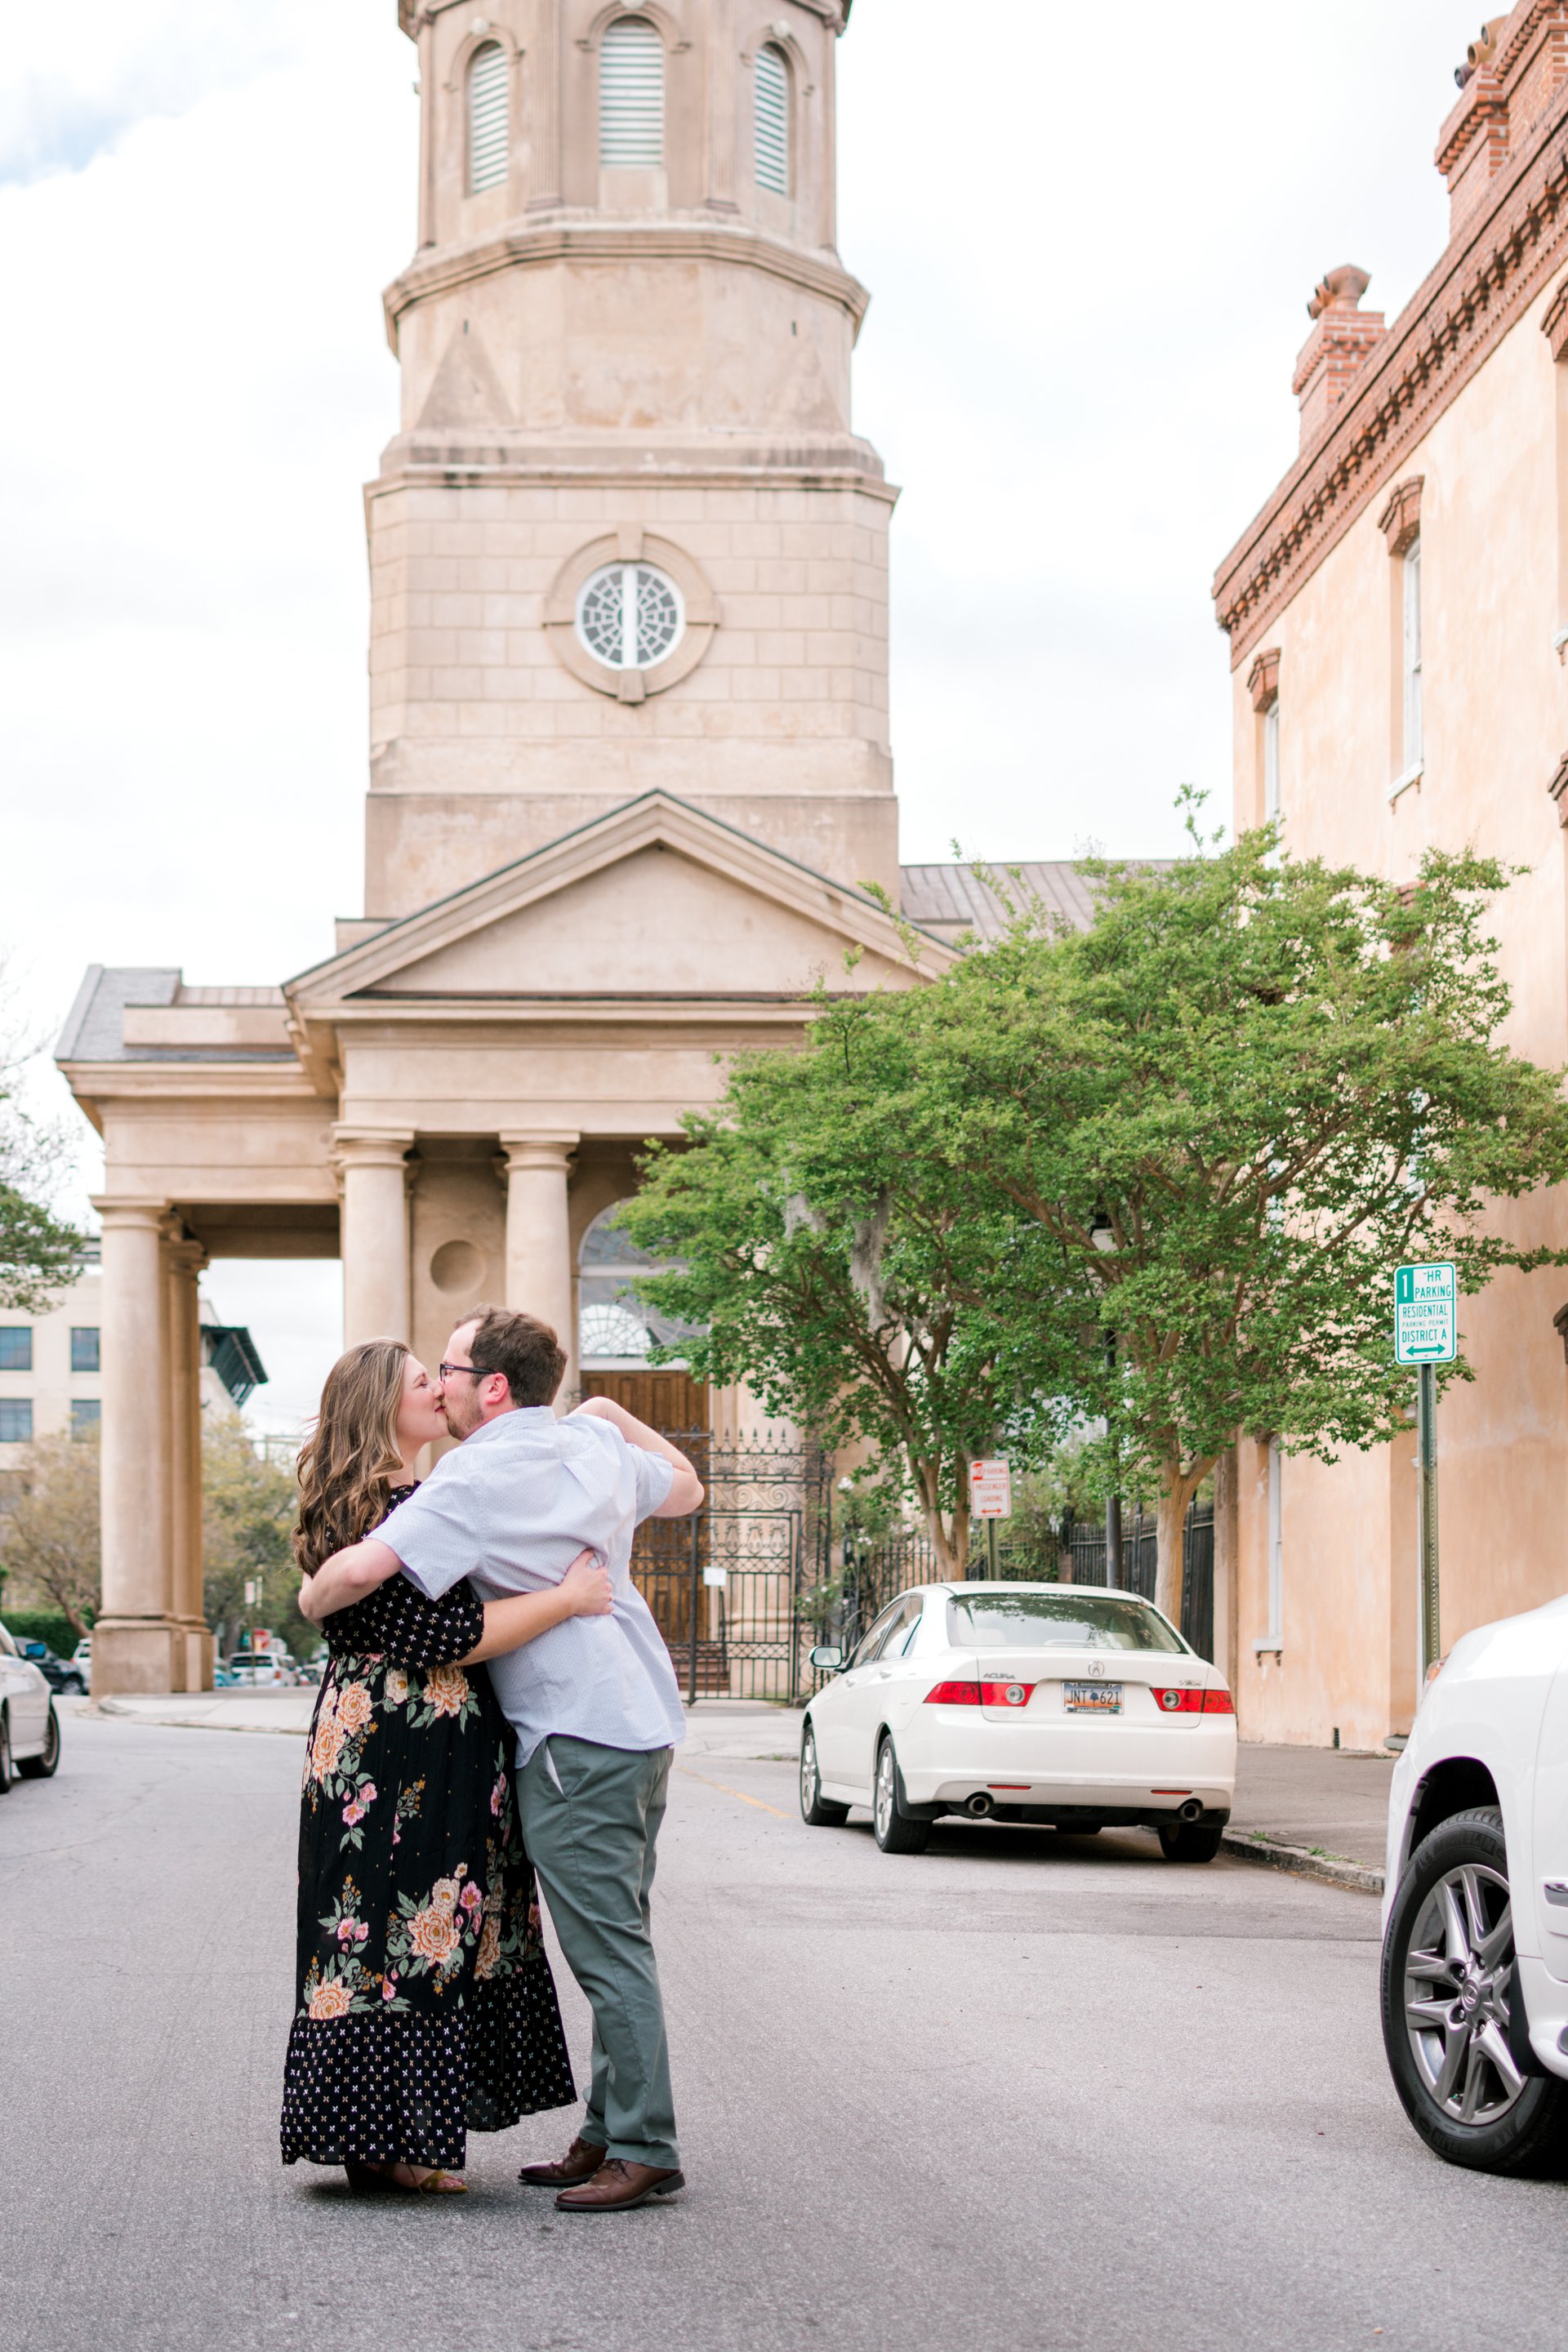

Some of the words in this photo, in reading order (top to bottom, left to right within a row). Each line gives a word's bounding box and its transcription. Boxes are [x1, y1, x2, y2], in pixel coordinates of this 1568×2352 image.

[1402, 1274, 1408, 1298] 1
[1427, 1270, 1441, 1281] HR
[1415, 1285, 1451, 1298] PARKING
[1402, 1304, 1448, 1318] RESIDENTIAL
[1428, 1318, 1449, 1326] PERMIT
[1402, 1330, 1437, 1343] DISTRICT
[1441, 1328, 1447, 1339] A
[976, 1482, 1006, 1490] PASSENGER
[980, 1494, 1003, 1503] LOADING
[1067, 1689, 1087, 1704] JNT
[1100, 1690, 1120, 1705] 621
